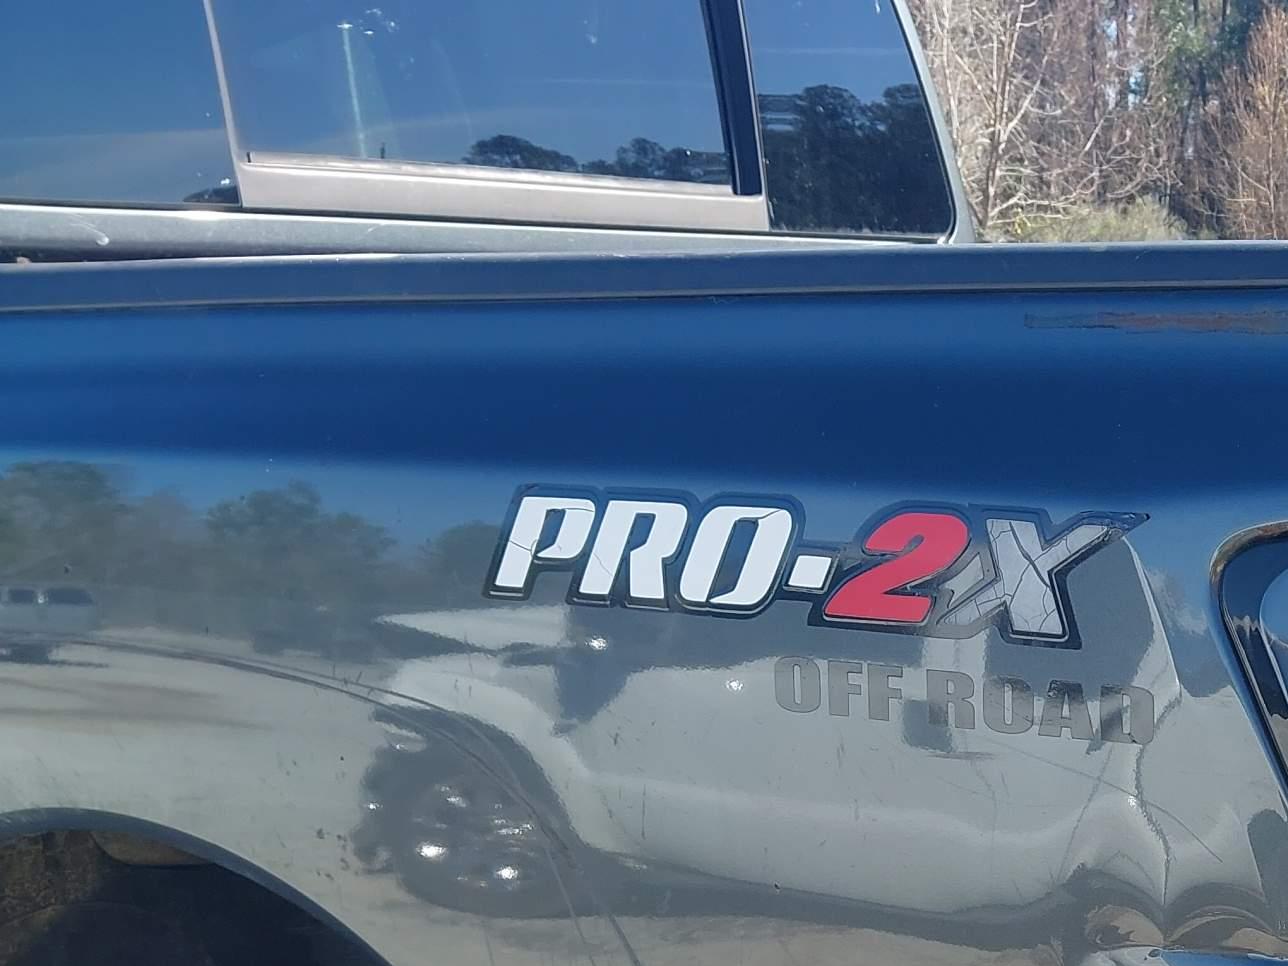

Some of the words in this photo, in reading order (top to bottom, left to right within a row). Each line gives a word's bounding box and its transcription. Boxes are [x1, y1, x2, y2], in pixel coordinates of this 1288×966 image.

[489, 486, 1149, 648] PRO-2X
[773, 656, 904, 722] OFF
[926, 668, 1156, 746] ROAD
